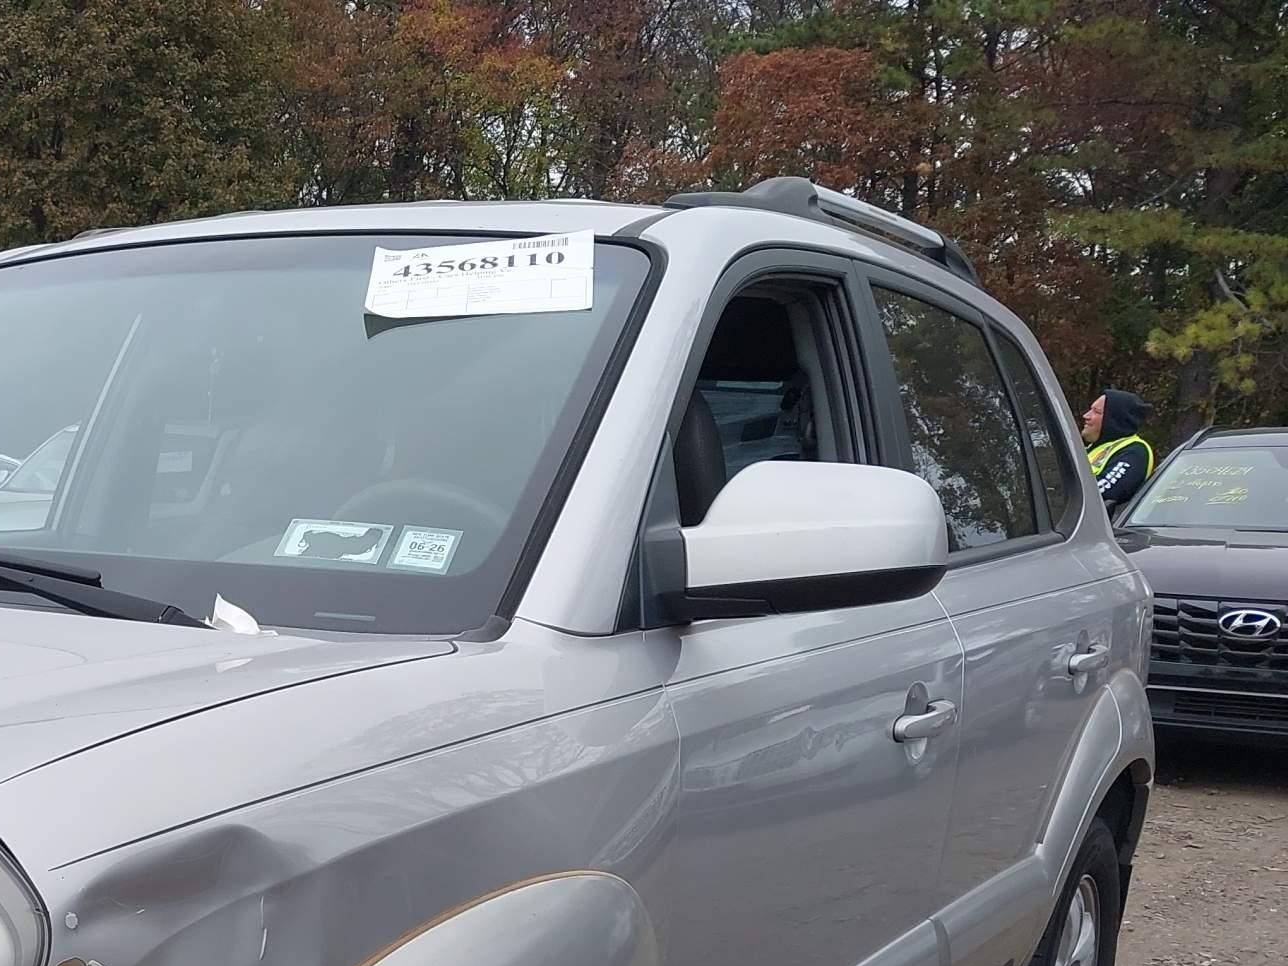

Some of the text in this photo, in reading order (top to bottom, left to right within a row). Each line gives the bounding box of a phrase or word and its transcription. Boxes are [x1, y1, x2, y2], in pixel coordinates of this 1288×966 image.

[393, 251, 565, 278] 43568110
[409, 541, 446, 553] 06 26
